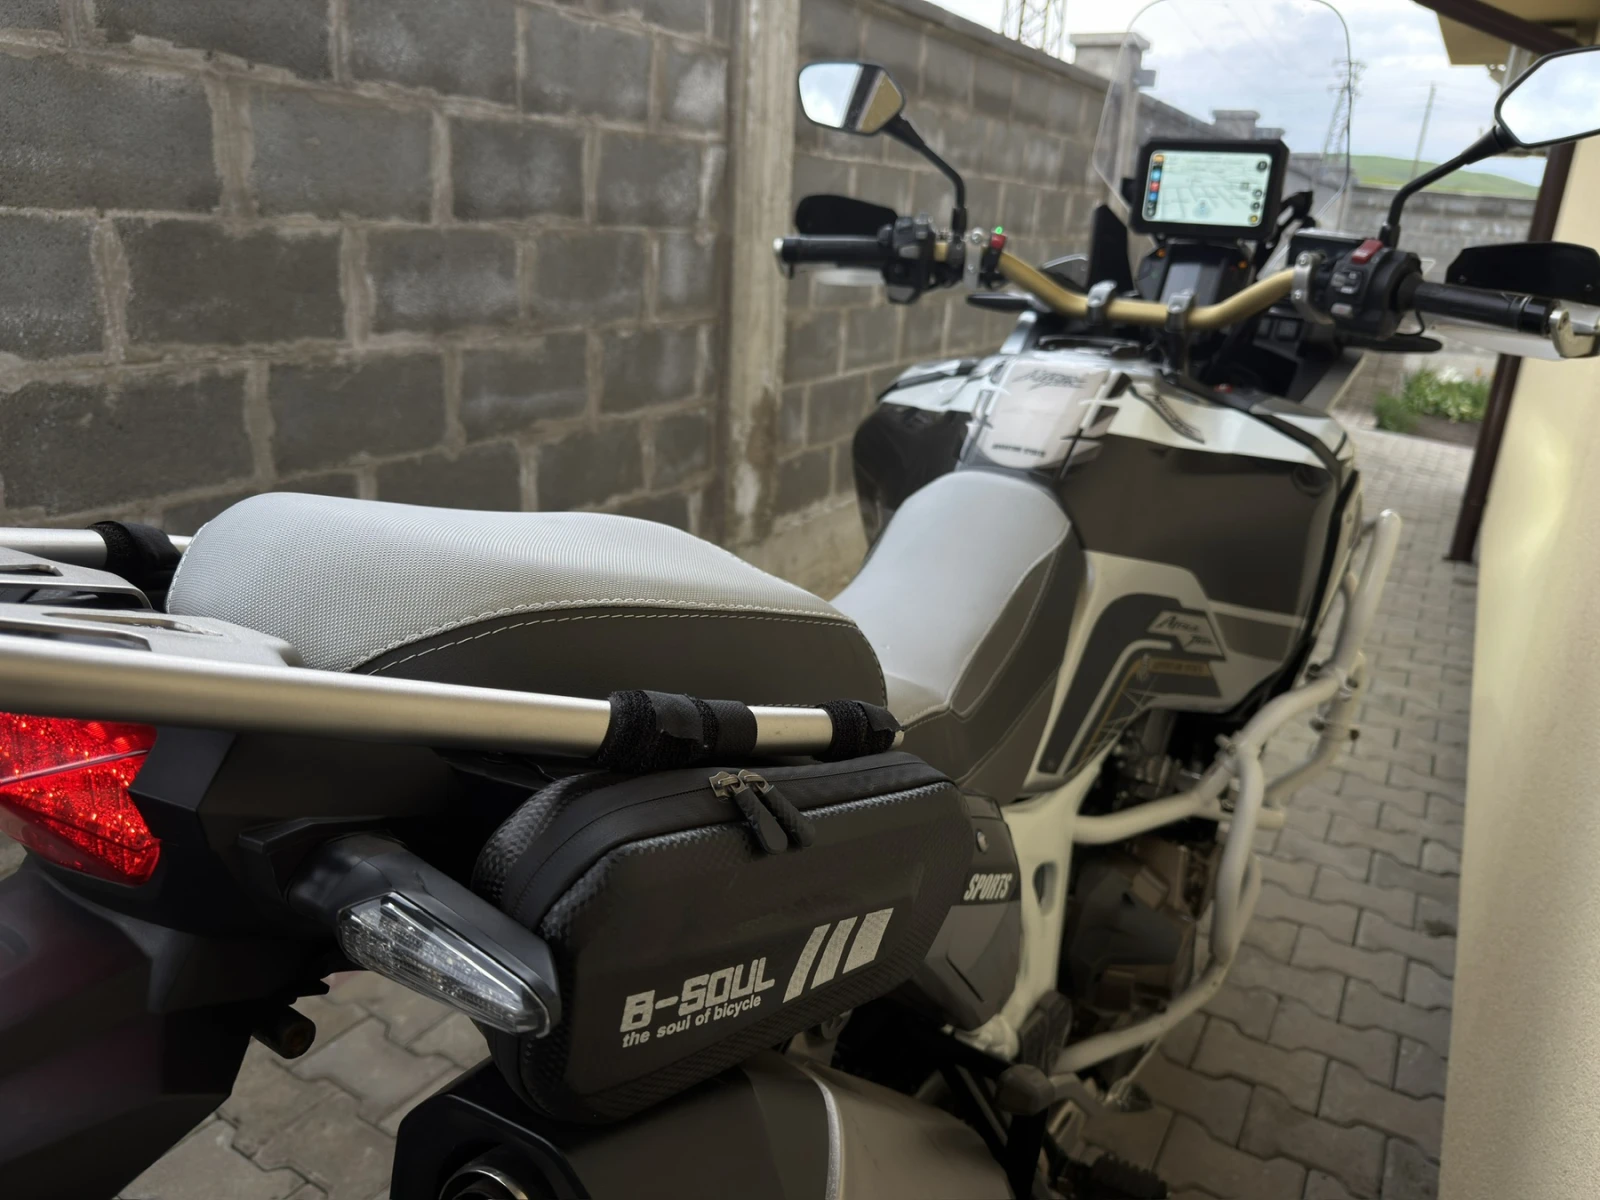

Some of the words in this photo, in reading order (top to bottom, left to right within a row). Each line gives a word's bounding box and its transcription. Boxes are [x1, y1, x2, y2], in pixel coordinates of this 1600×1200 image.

[963, 873, 1013, 901] SPORTS
[620, 957, 775, 1032] B-SOUL
[622, 1031, 650, 1048] the
[656, 1015, 691, 1038] soul
[695, 1007, 711, 1026] of
[713, 994, 761, 1021] bicycle
